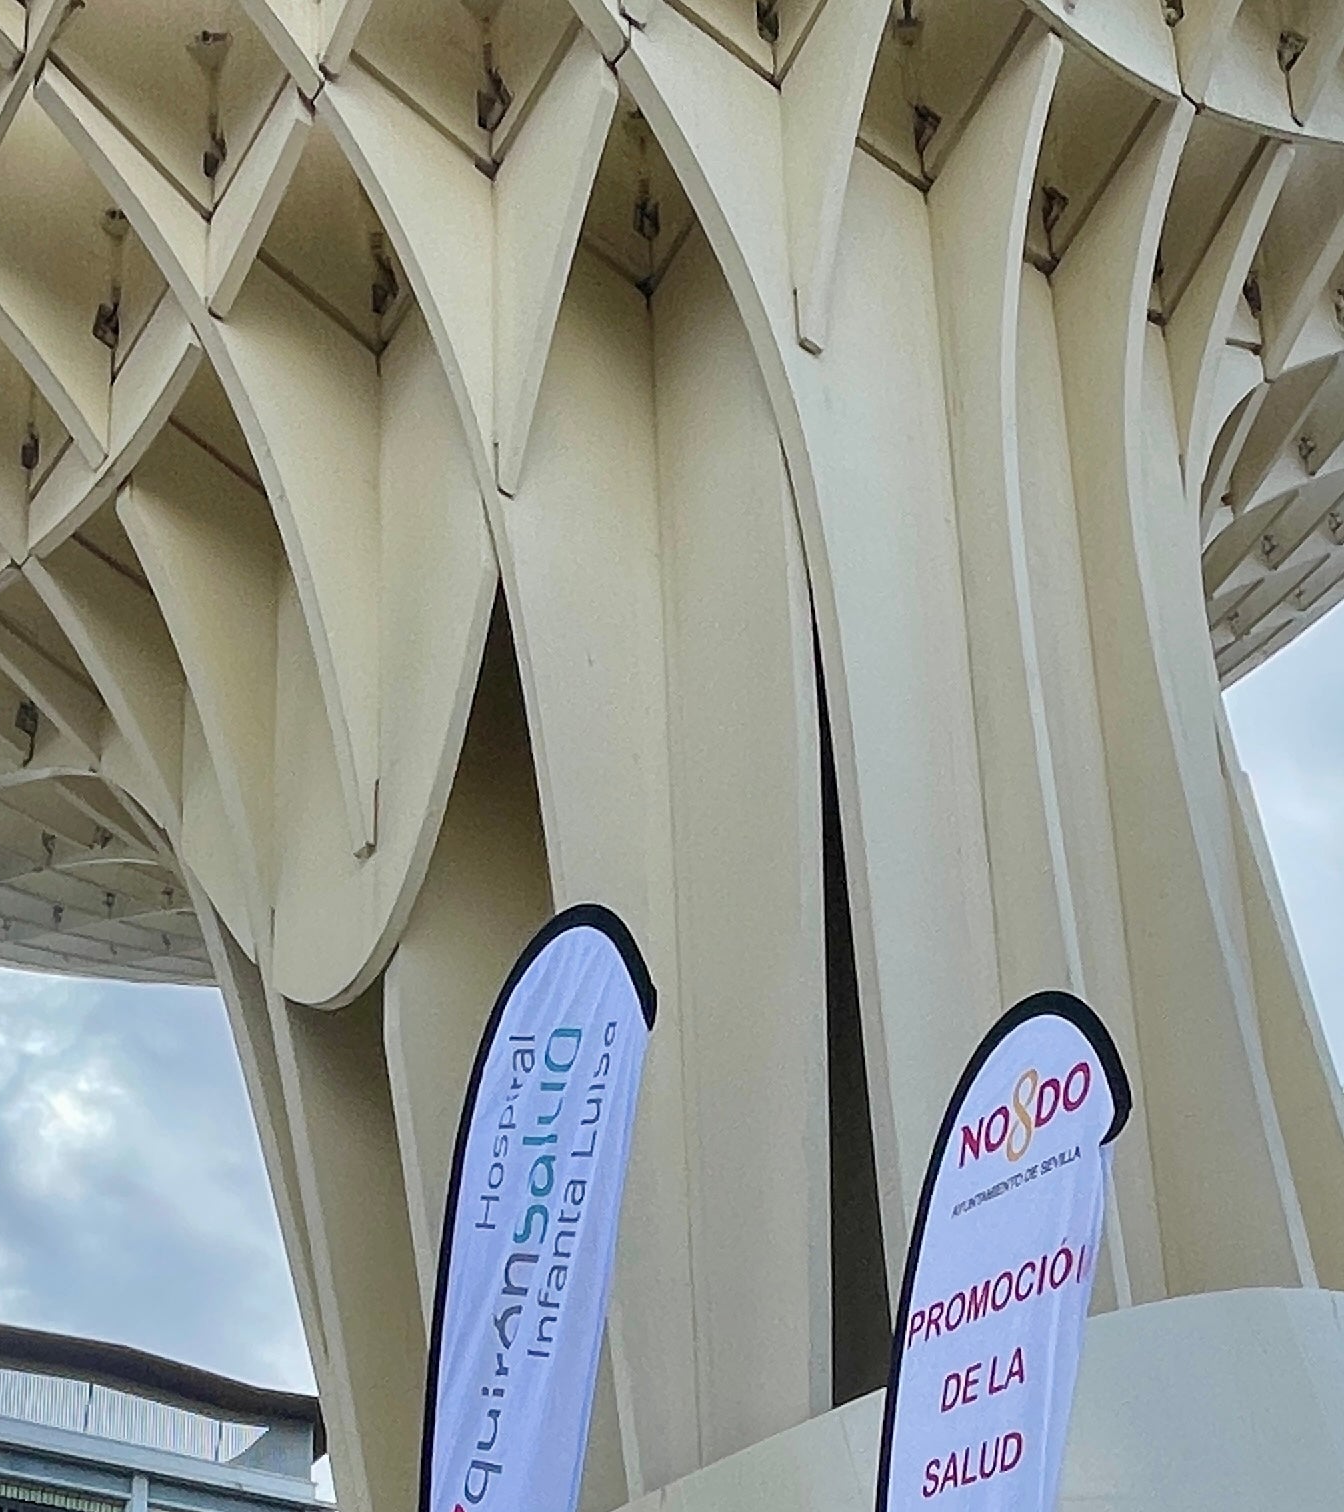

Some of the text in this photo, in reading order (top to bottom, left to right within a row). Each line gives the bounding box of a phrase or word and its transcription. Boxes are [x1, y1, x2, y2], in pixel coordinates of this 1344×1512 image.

[527, 1021, 618, 1358] Infanta Luisa
[941, 1347, 1025, 1413] DE LA
[922, 1432, 1023, 1498] SALUD
